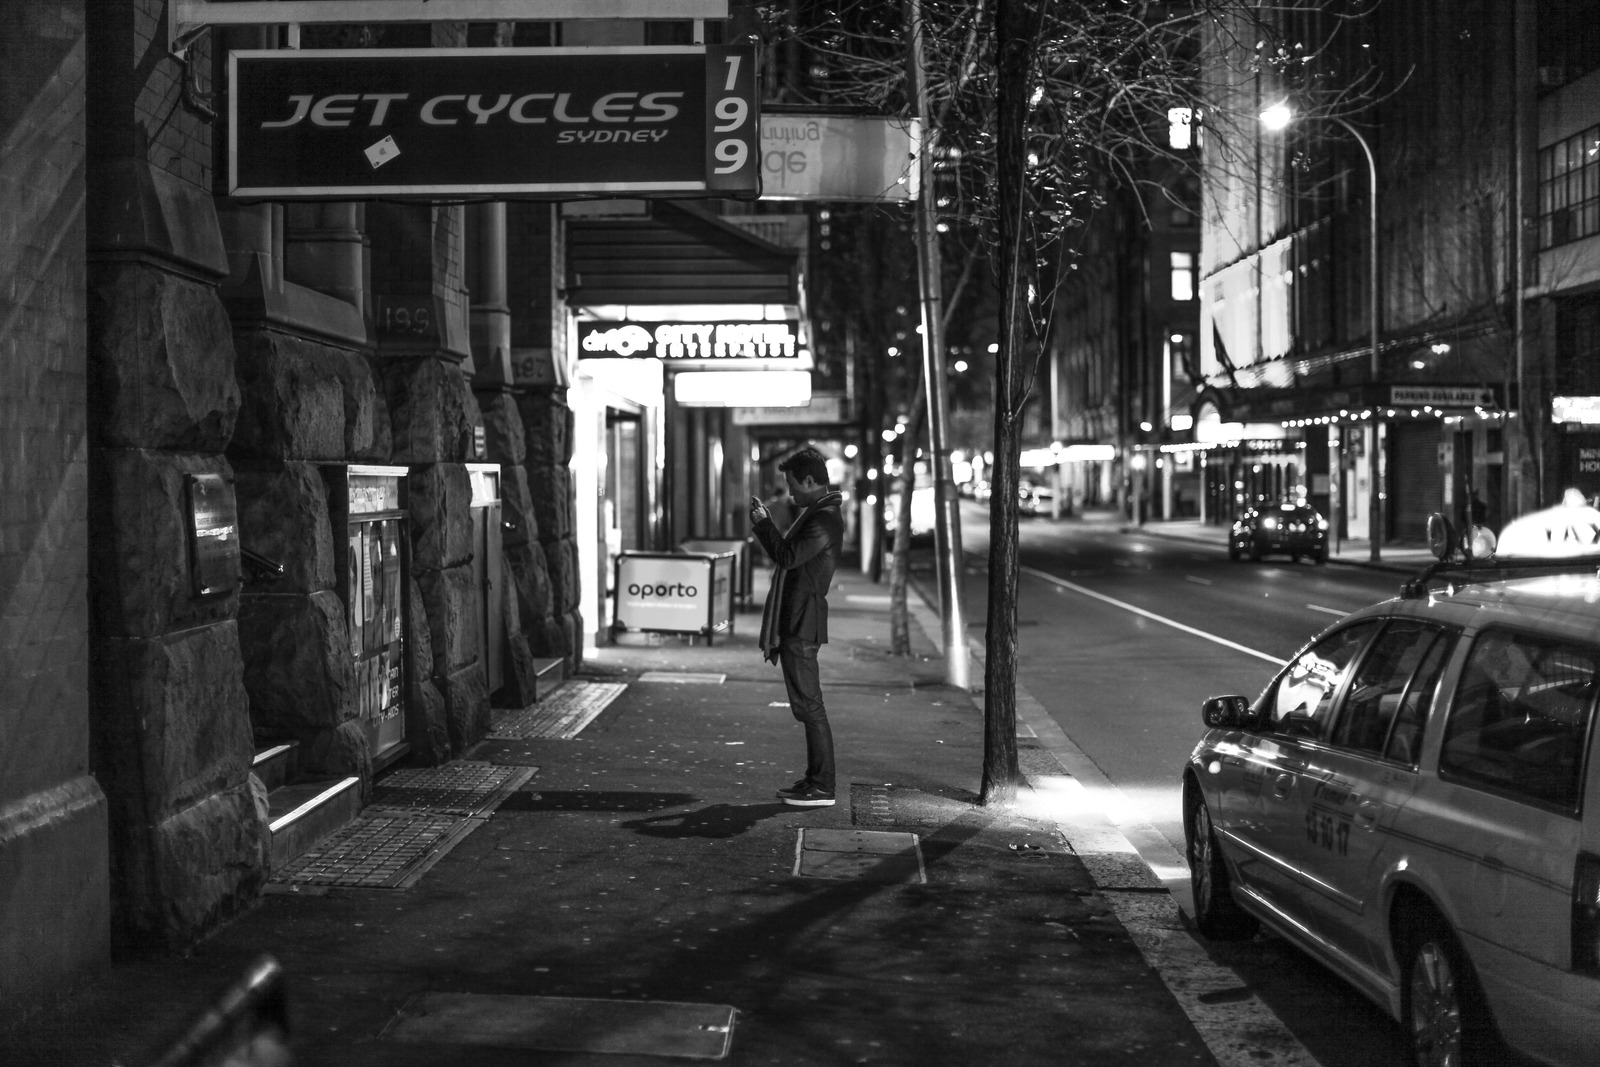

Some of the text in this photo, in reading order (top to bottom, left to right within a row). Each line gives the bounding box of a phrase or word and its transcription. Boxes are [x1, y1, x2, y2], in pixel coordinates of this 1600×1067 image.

[260, 91, 685, 129] JET CYCLES
[556, 129, 669, 144] SYDNEY
[627, 582, 698, 600] oporto
